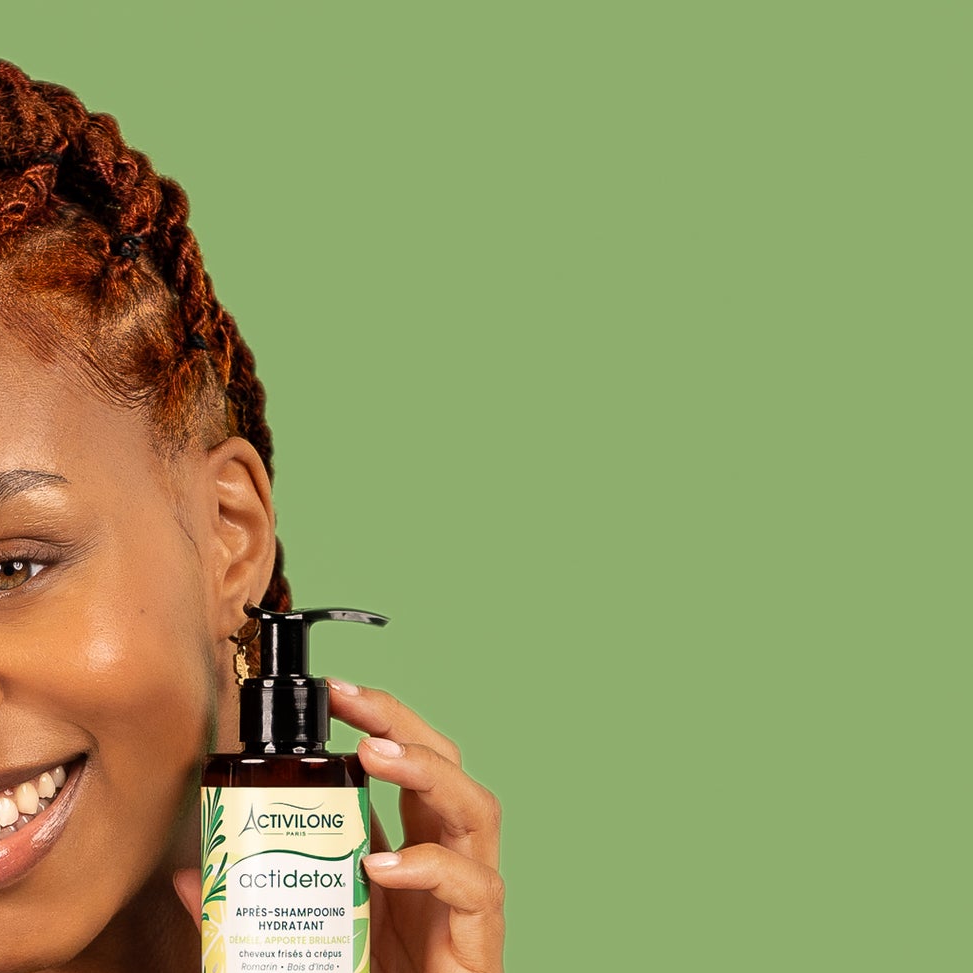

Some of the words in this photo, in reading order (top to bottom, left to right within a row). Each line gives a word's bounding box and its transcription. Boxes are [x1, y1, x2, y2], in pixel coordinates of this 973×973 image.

[238, 803, 345, 837] ACTIVILONG
[239, 870, 344, 889] actidetox
[235, 905, 346, 918] APRÈS-SHAMPOOING
[258, 920, 324, 931] HYDRATANT
[264, 936, 306, 945] APPORTE
[309, 935, 351, 944] BRILLANCE
[238, 949, 276, 958] cheveux
[277, 949, 303, 958] frisés
[305, 949, 312, 958] à
[314, 949, 342, 960] crépus
[241, 963, 278, 971] Romarin
[287, 962, 306, 971] Bois
[308, 962, 335, 971] d'Inde
